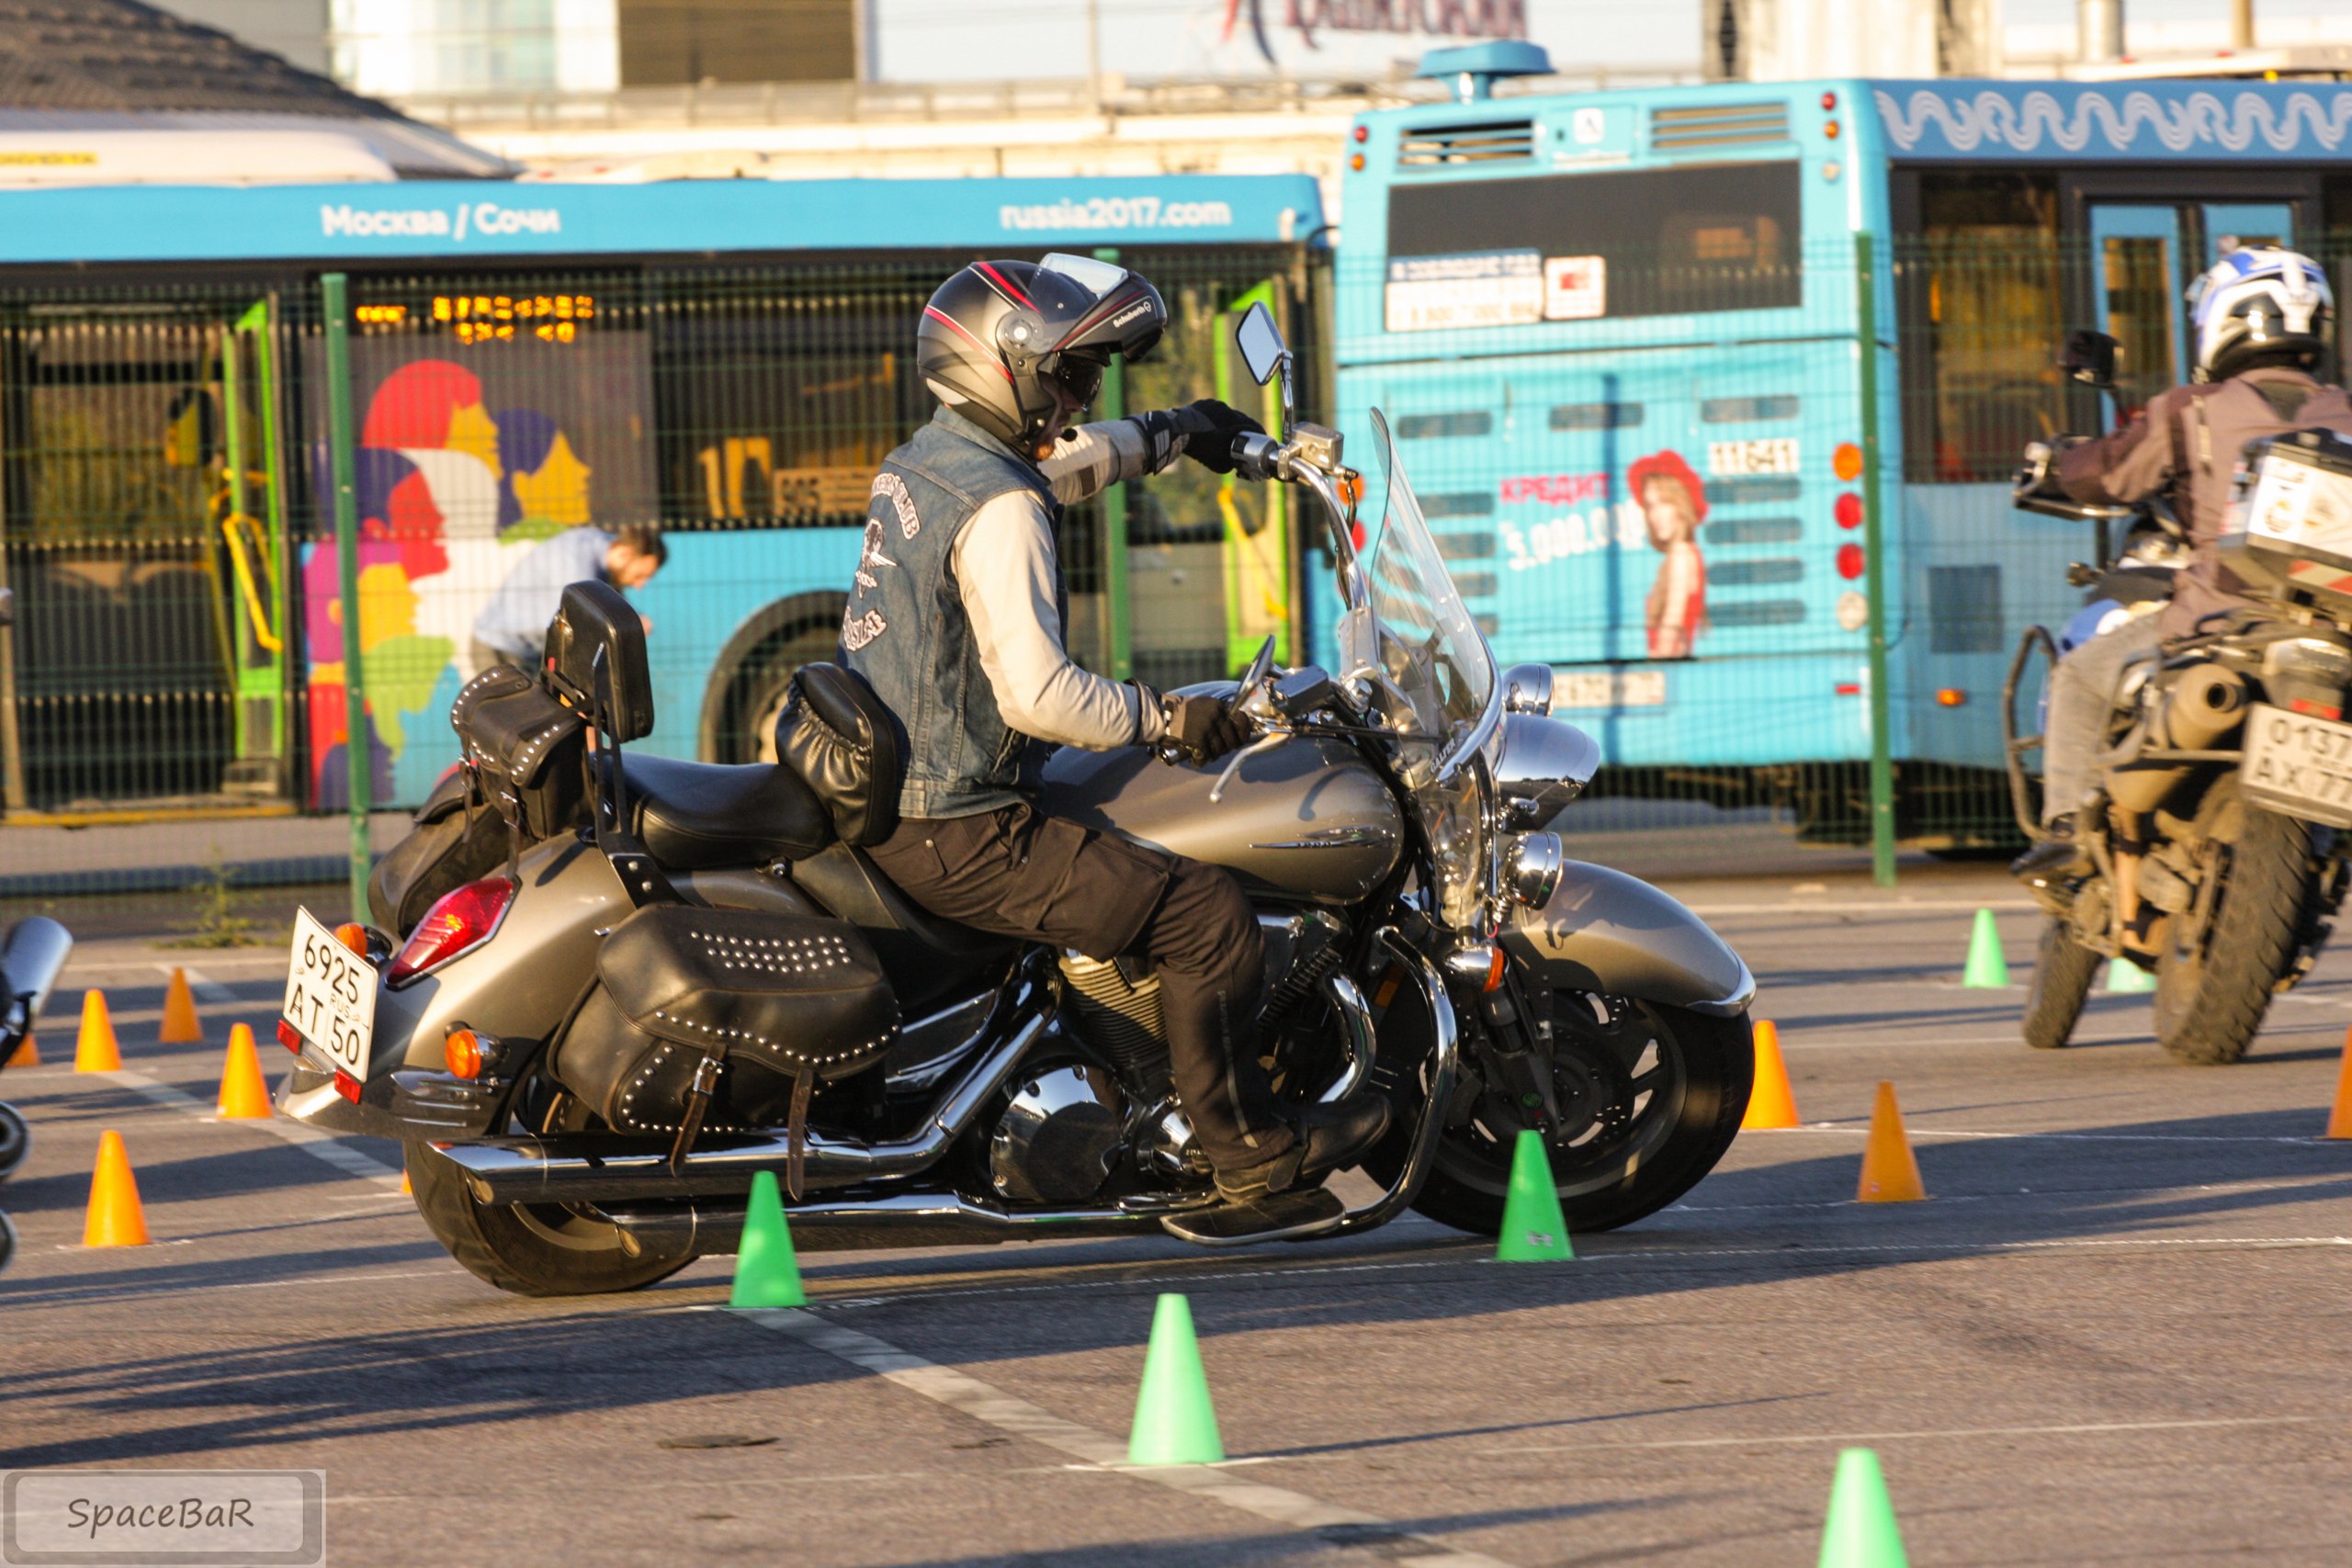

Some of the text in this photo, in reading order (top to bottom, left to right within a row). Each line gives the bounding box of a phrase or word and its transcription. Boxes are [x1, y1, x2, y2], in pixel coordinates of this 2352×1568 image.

[321, 205, 449, 236] Москва
[474, 202, 560, 233] Сочи
[1000, 196, 1232, 230] russia2017.com
[1113, 305, 1147, 328] Schuberth
[1499, 471, 1611, 507] КРЕДИТ
[304, 933, 360, 1005] 6925
[288, 982, 324, 1034] AT
[329, 993, 351, 1021] RUS
[331, 1015, 360, 1066] 50
